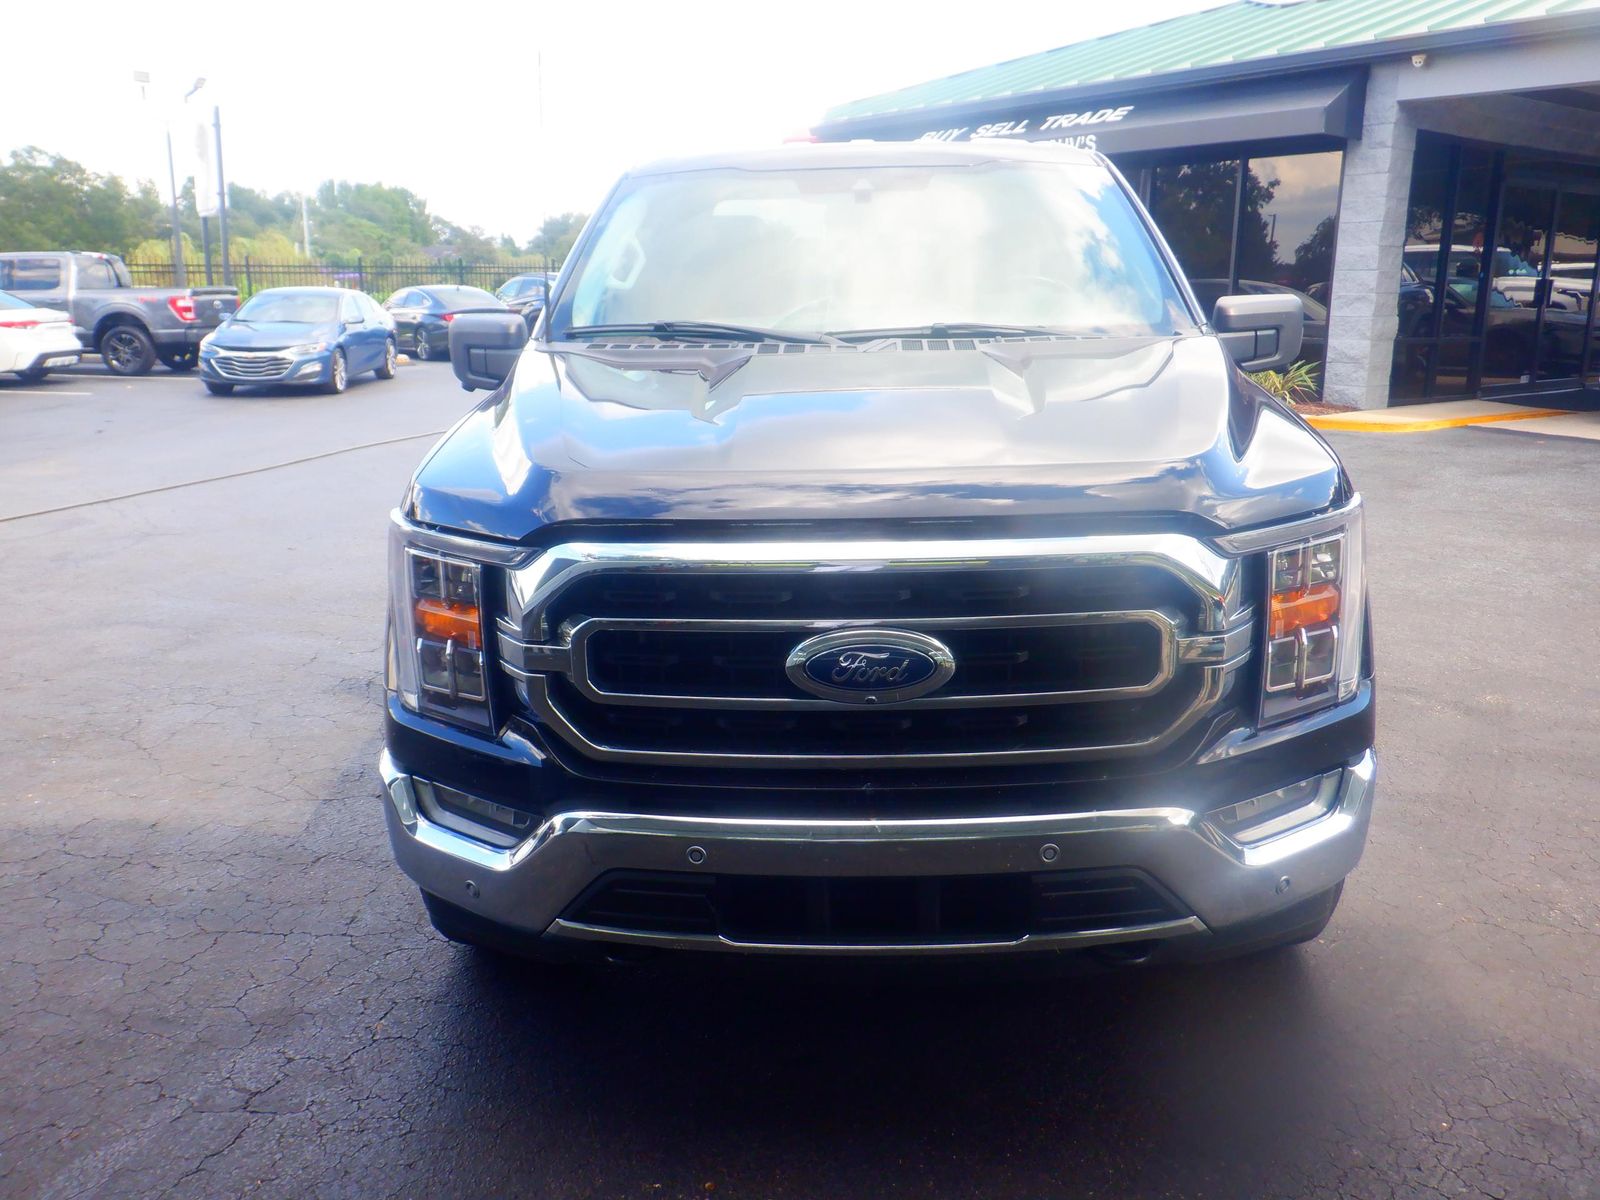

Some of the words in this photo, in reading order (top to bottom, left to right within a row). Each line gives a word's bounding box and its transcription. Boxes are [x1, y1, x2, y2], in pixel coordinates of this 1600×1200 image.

[970, 120, 1029, 138] SELL
[1040, 106, 1135, 130] TRADE
[831, 651, 909, 682] Ford
